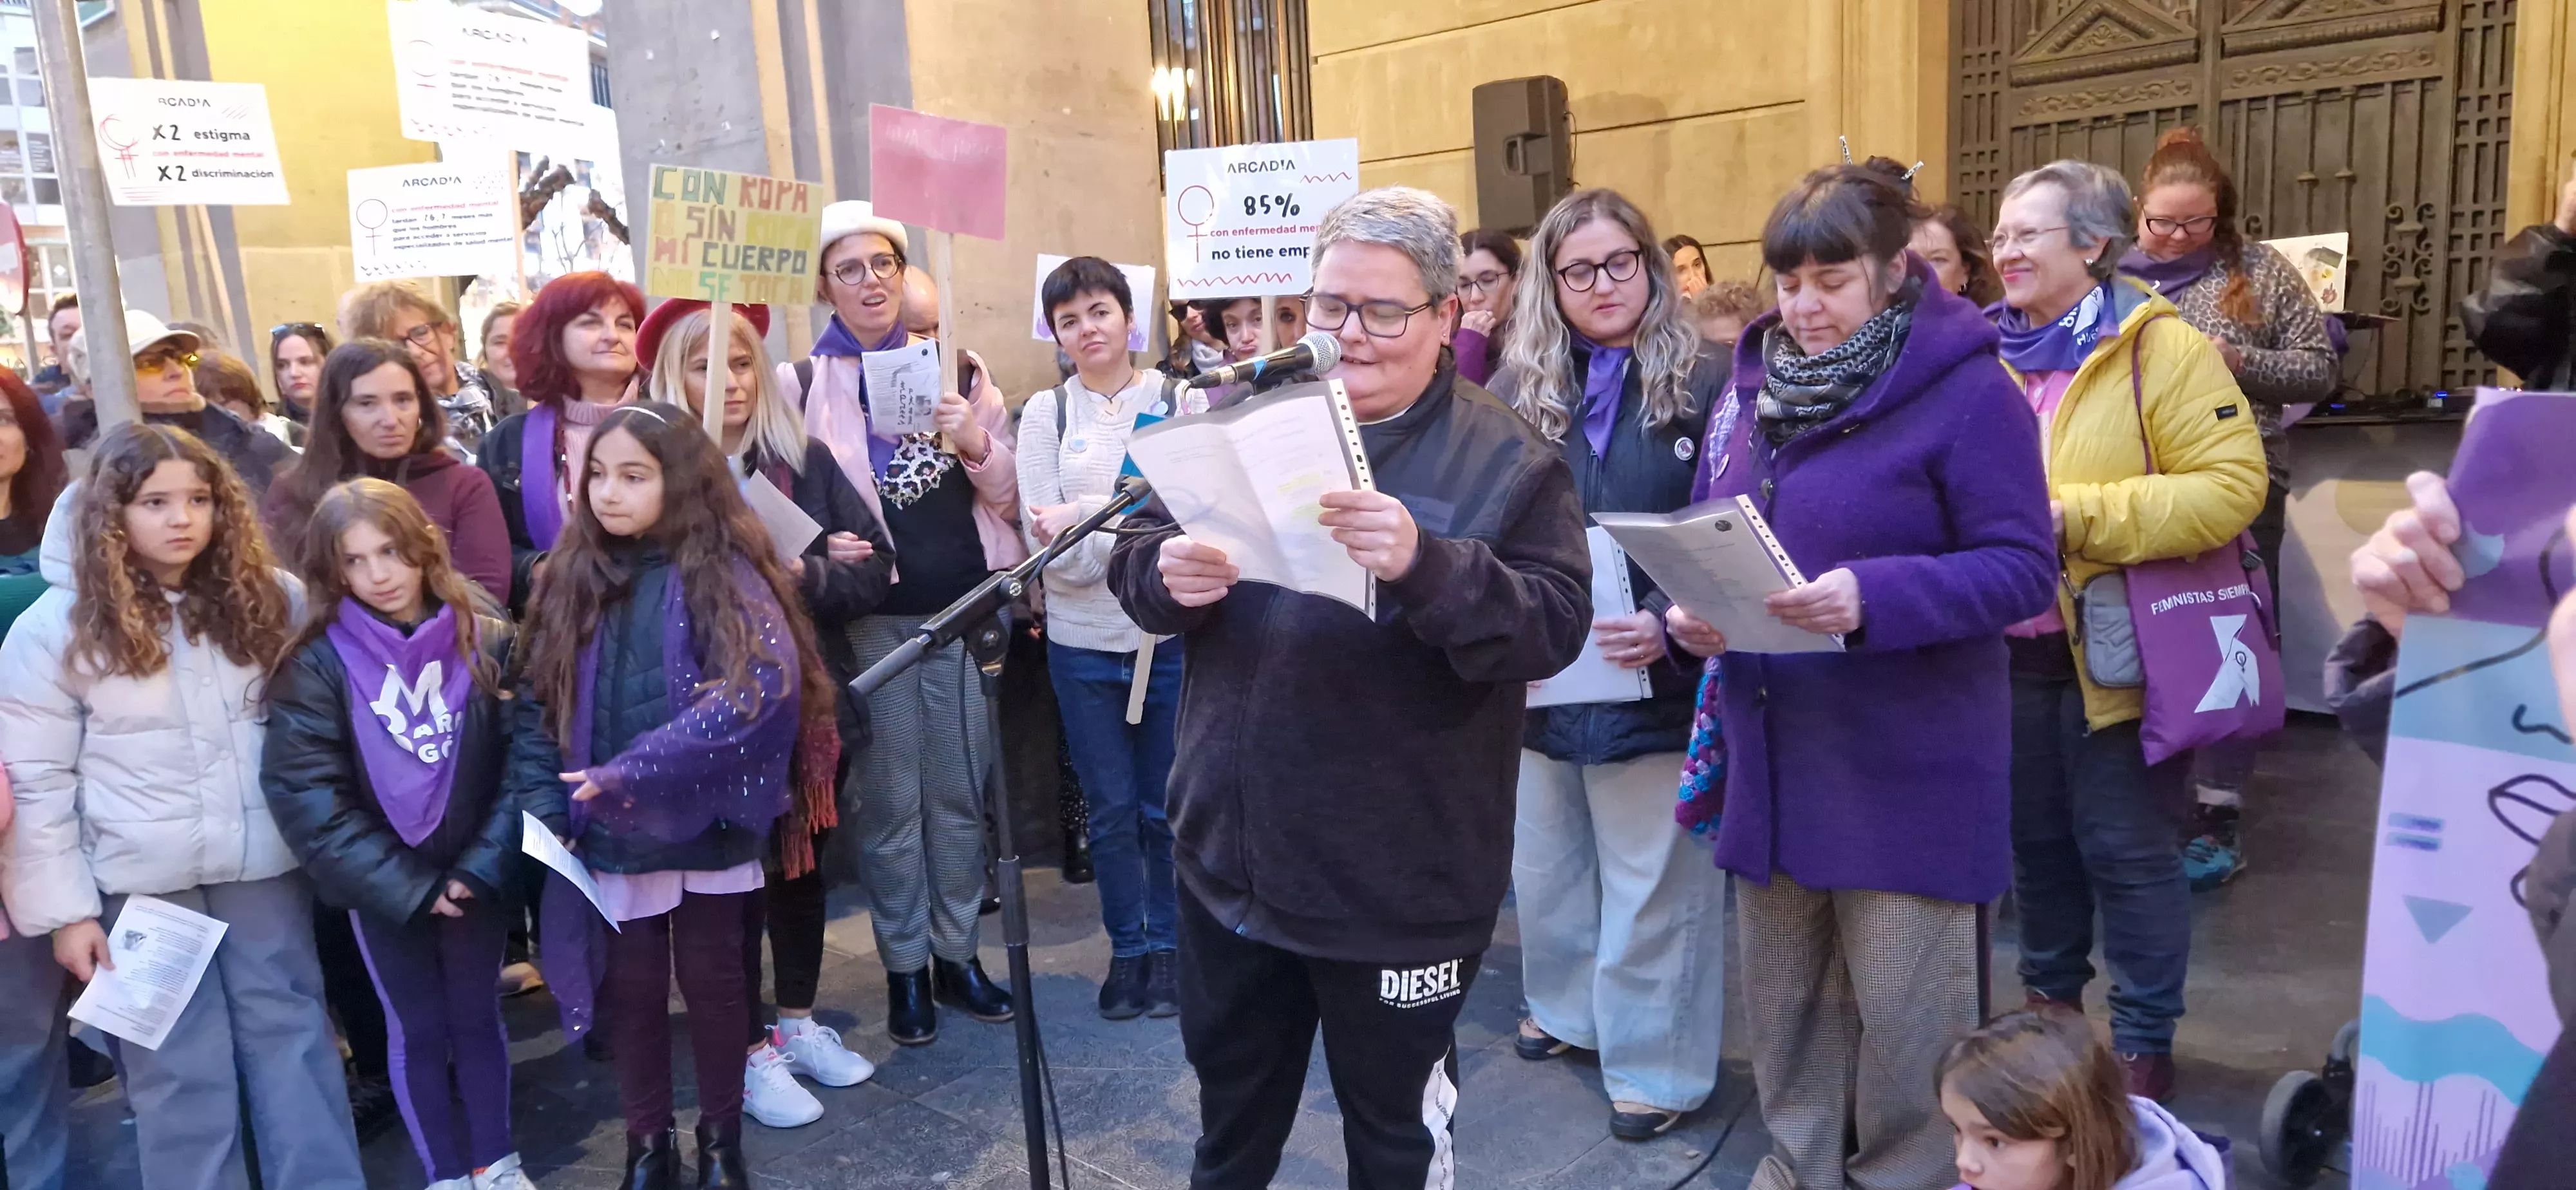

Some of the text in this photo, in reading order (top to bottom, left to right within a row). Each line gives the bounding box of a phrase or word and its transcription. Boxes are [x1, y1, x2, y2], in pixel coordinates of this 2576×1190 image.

[193, 129, 251, 142] estigma
[653, 165, 808, 214] CON ROPA
[1244, 193, 1301, 218] 85%
[1210, 229, 1229, 237] con
[1232, 225, 1296, 237] enfermedad
[701, 241, 808, 274] CUERPO
[1211, 250, 1231, 260] no
[1235, 245, 1274, 260] tiene
[699, 271, 732, 302] SE
[739, 274, 804, 305] TOCA
[1380, 958, 1461, 1002] DIESEL
